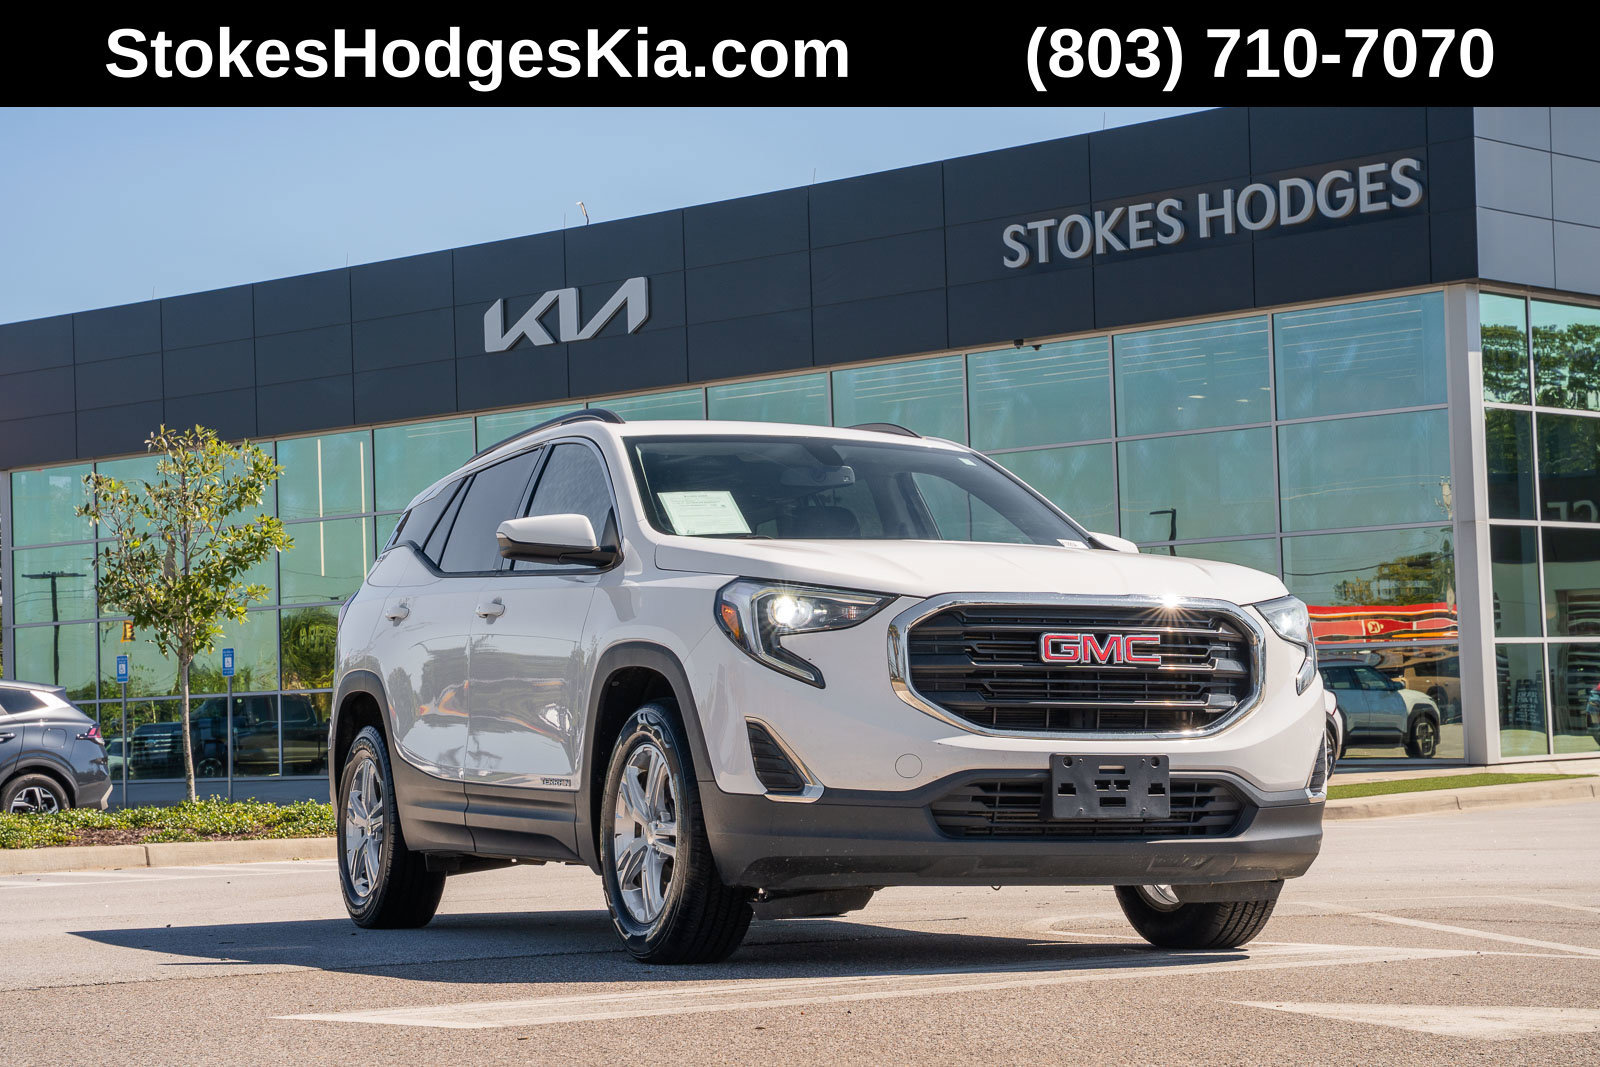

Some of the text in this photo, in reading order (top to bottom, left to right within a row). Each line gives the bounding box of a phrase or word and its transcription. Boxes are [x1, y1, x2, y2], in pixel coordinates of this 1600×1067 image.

[1002, 157, 1424, 269] STOKES HODGES
[484, 276, 649, 353] KIA
[1041, 633, 1162, 665] GMC
